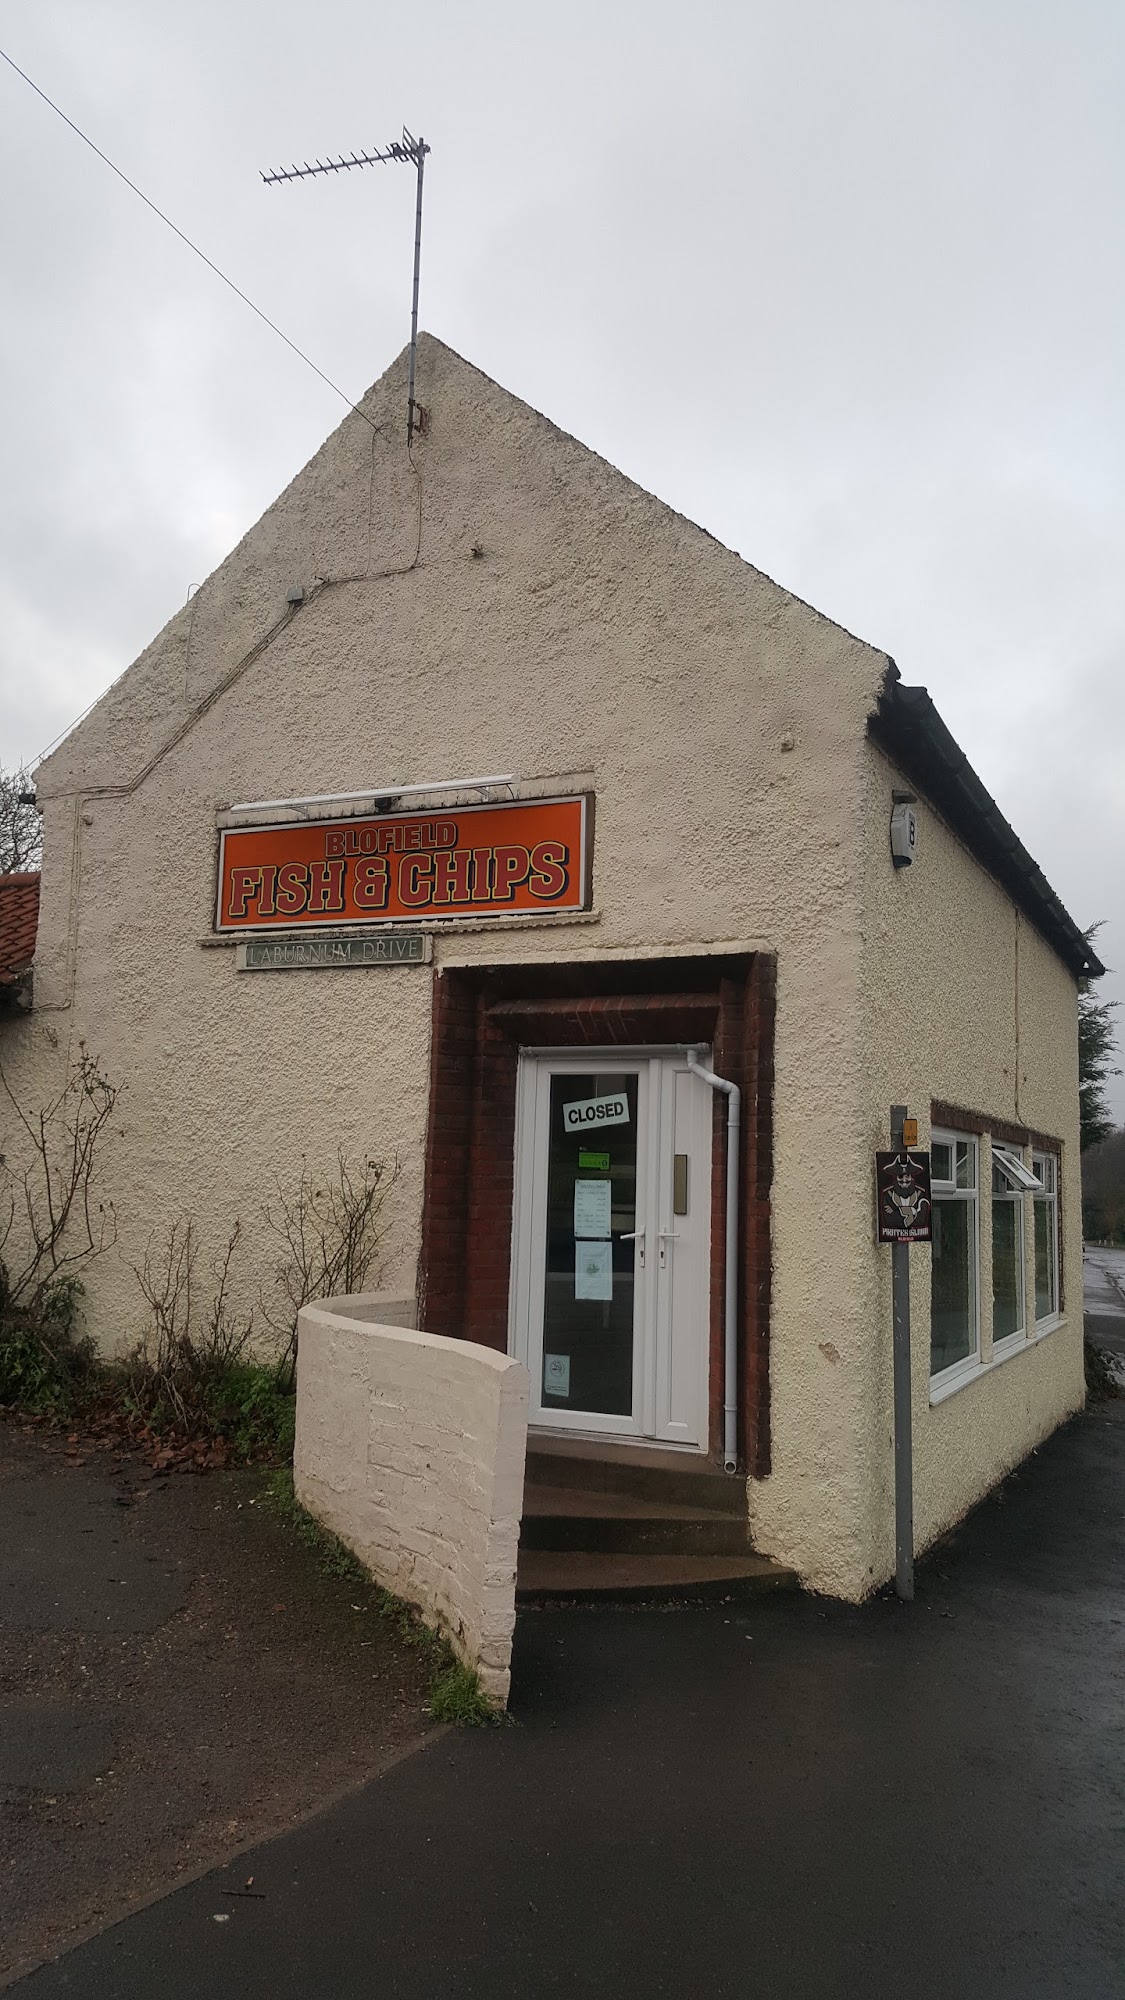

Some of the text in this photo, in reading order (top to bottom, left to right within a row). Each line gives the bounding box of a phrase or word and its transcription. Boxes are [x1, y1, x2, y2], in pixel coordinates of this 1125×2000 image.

[325, 821, 458, 858] BLOFIELD
[229, 841, 569, 917] FISH & CHIPS
[250, 940, 418, 964] LABURNUM DRIVE
[568, 1101, 624, 1125] CLOSED
